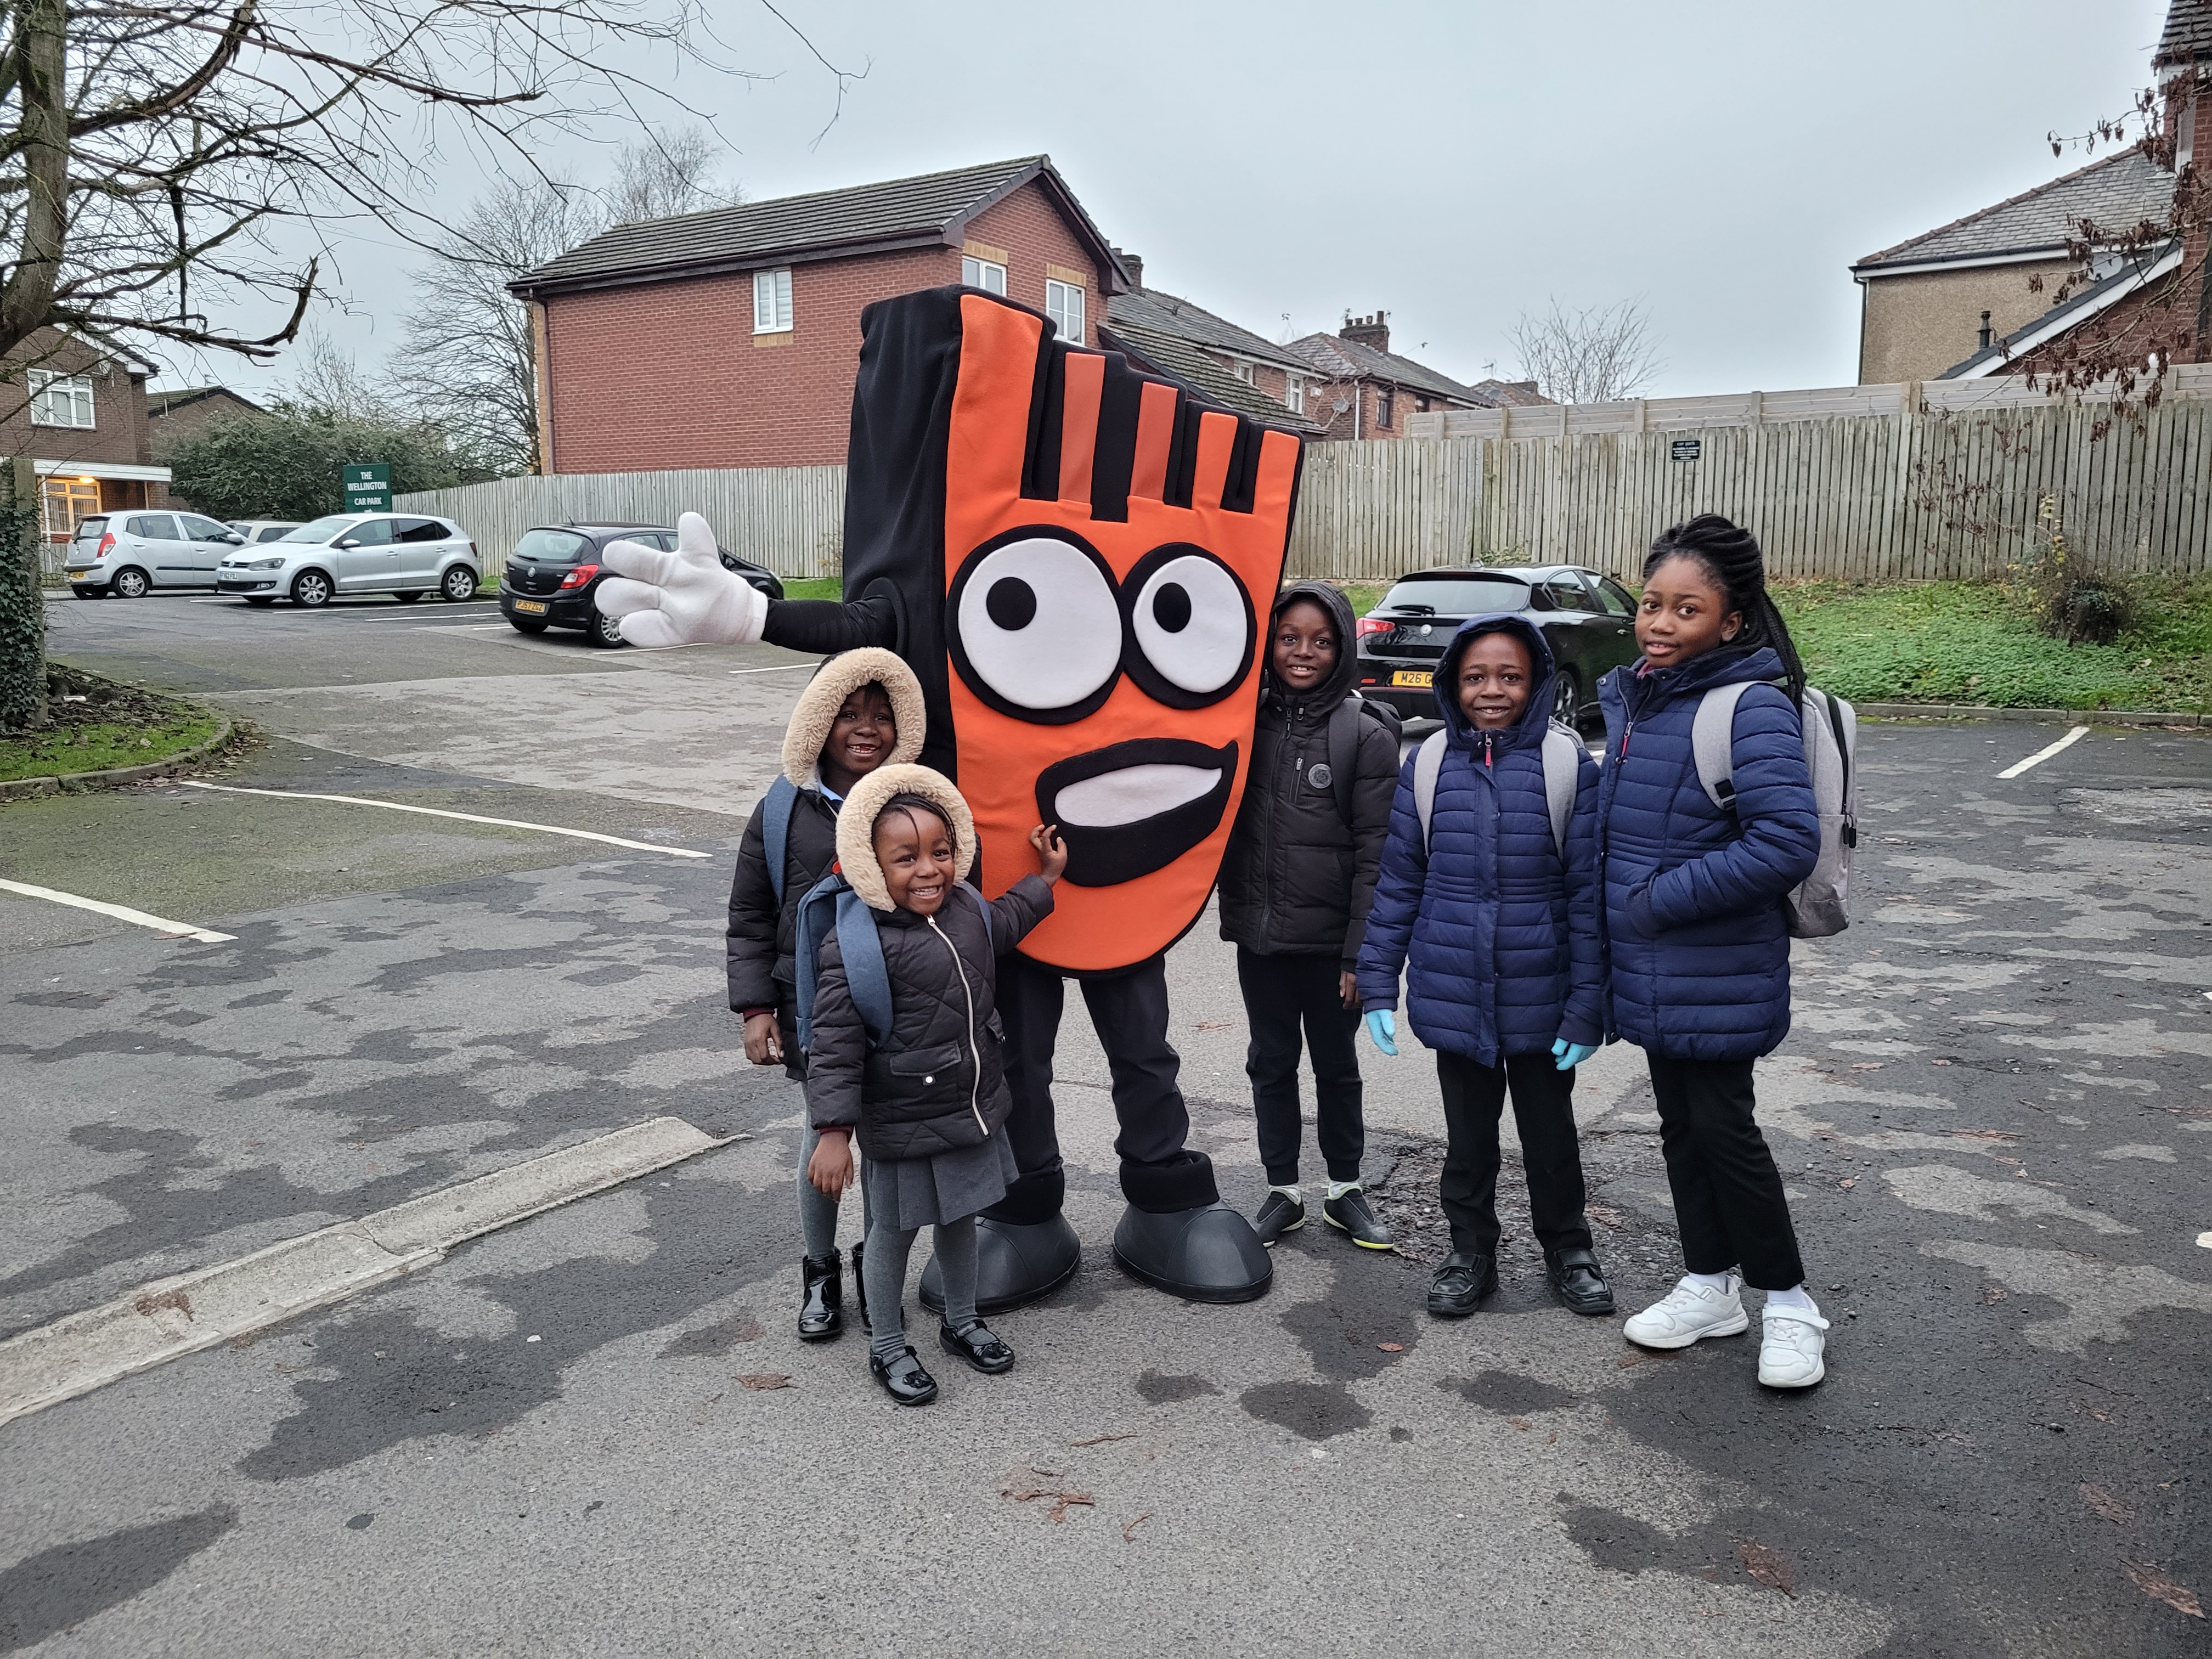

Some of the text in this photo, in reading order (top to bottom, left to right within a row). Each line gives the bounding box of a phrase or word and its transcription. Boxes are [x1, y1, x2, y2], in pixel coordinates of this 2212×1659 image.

[360, 471, 373, 480] THE
[347, 481, 387, 491] WELLINGTON
[1401, 673, 1422, 684] M26
